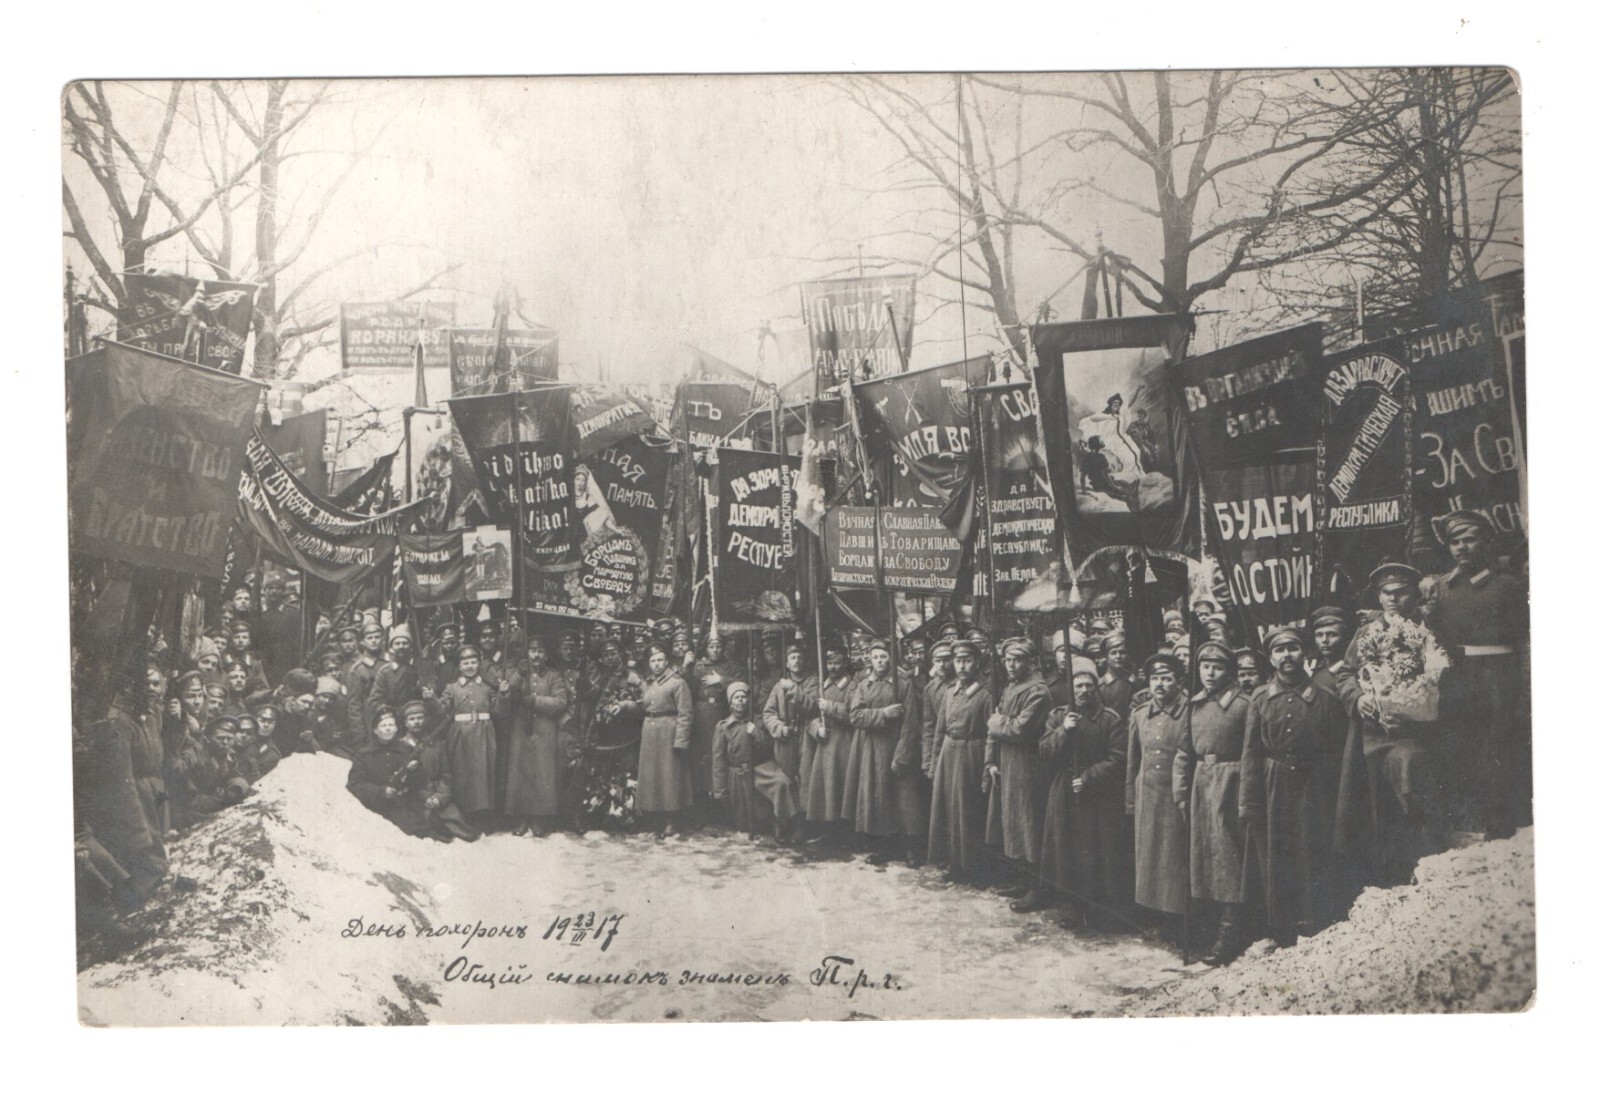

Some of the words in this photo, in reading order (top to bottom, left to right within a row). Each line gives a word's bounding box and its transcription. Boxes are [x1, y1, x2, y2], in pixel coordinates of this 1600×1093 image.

[1328, 394, 1402, 505] ДЕМОКРАТИЧЕСКАЯ
[1213, 493, 1313, 541] БУДЕМ
[1328, 500, 1400, 529] РЕСПУБЛИКА
[341, 915, 407, 939] День
[443, 955, 533, 989] Общій
